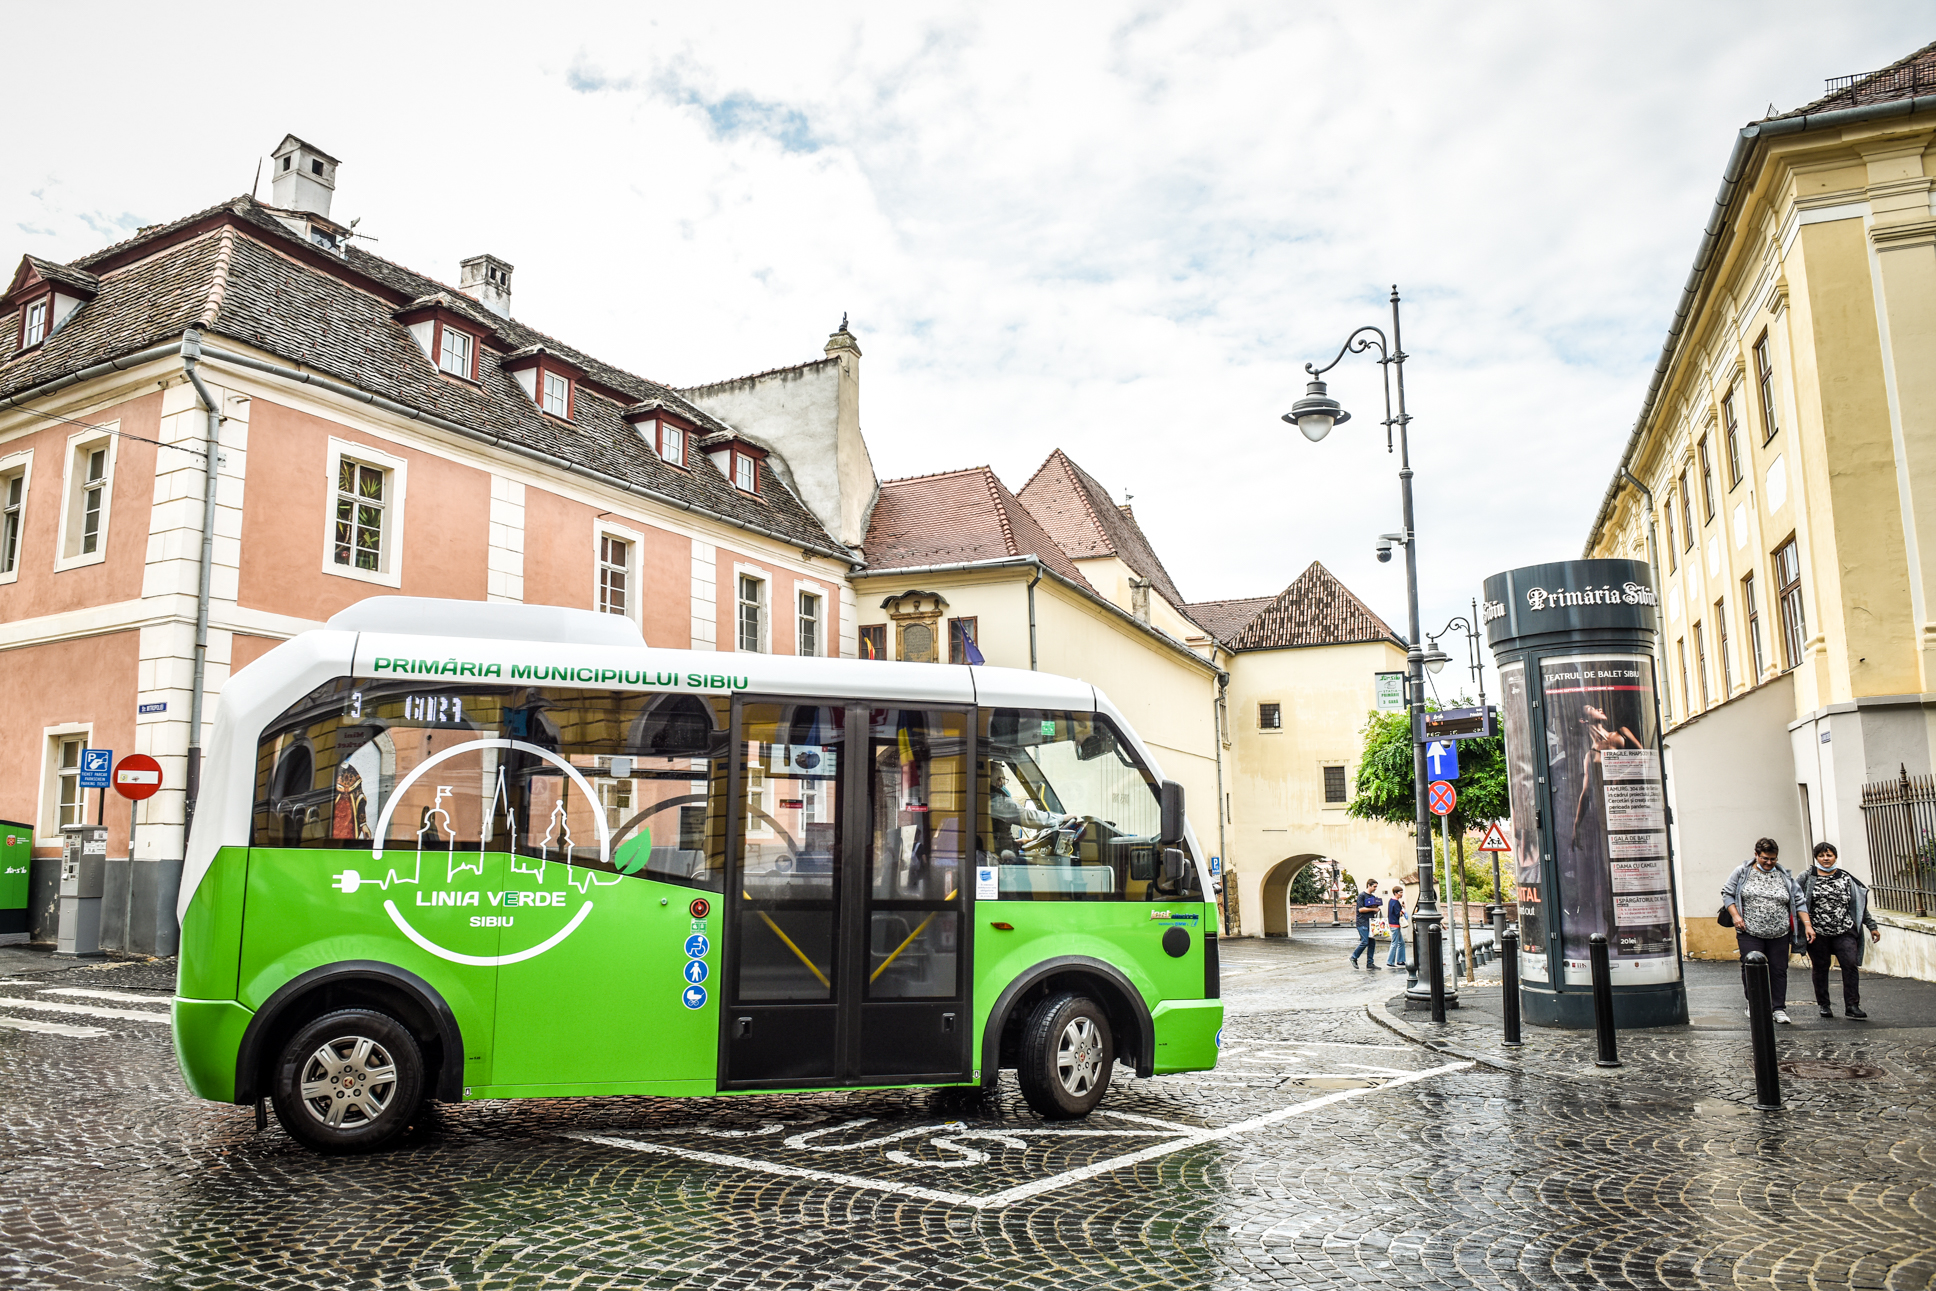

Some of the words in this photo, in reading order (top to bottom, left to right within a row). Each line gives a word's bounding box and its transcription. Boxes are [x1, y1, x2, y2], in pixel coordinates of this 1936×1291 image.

[1526, 586, 1622, 611] Primăria
[511, 664, 679, 687] MUNICIPIULUI
[687, 673, 749, 690] SIBIU
[1544, 671, 1582, 682] TEATRUL
[1584, 671, 1596, 679] DE
[1598, 670, 1622, 678] BALET
[350, 692, 362, 718] 3
[416, 891, 480, 907] LINIA
[487, 891, 567, 907] VERDE
[469, 915, 514, 928] SIBIU
